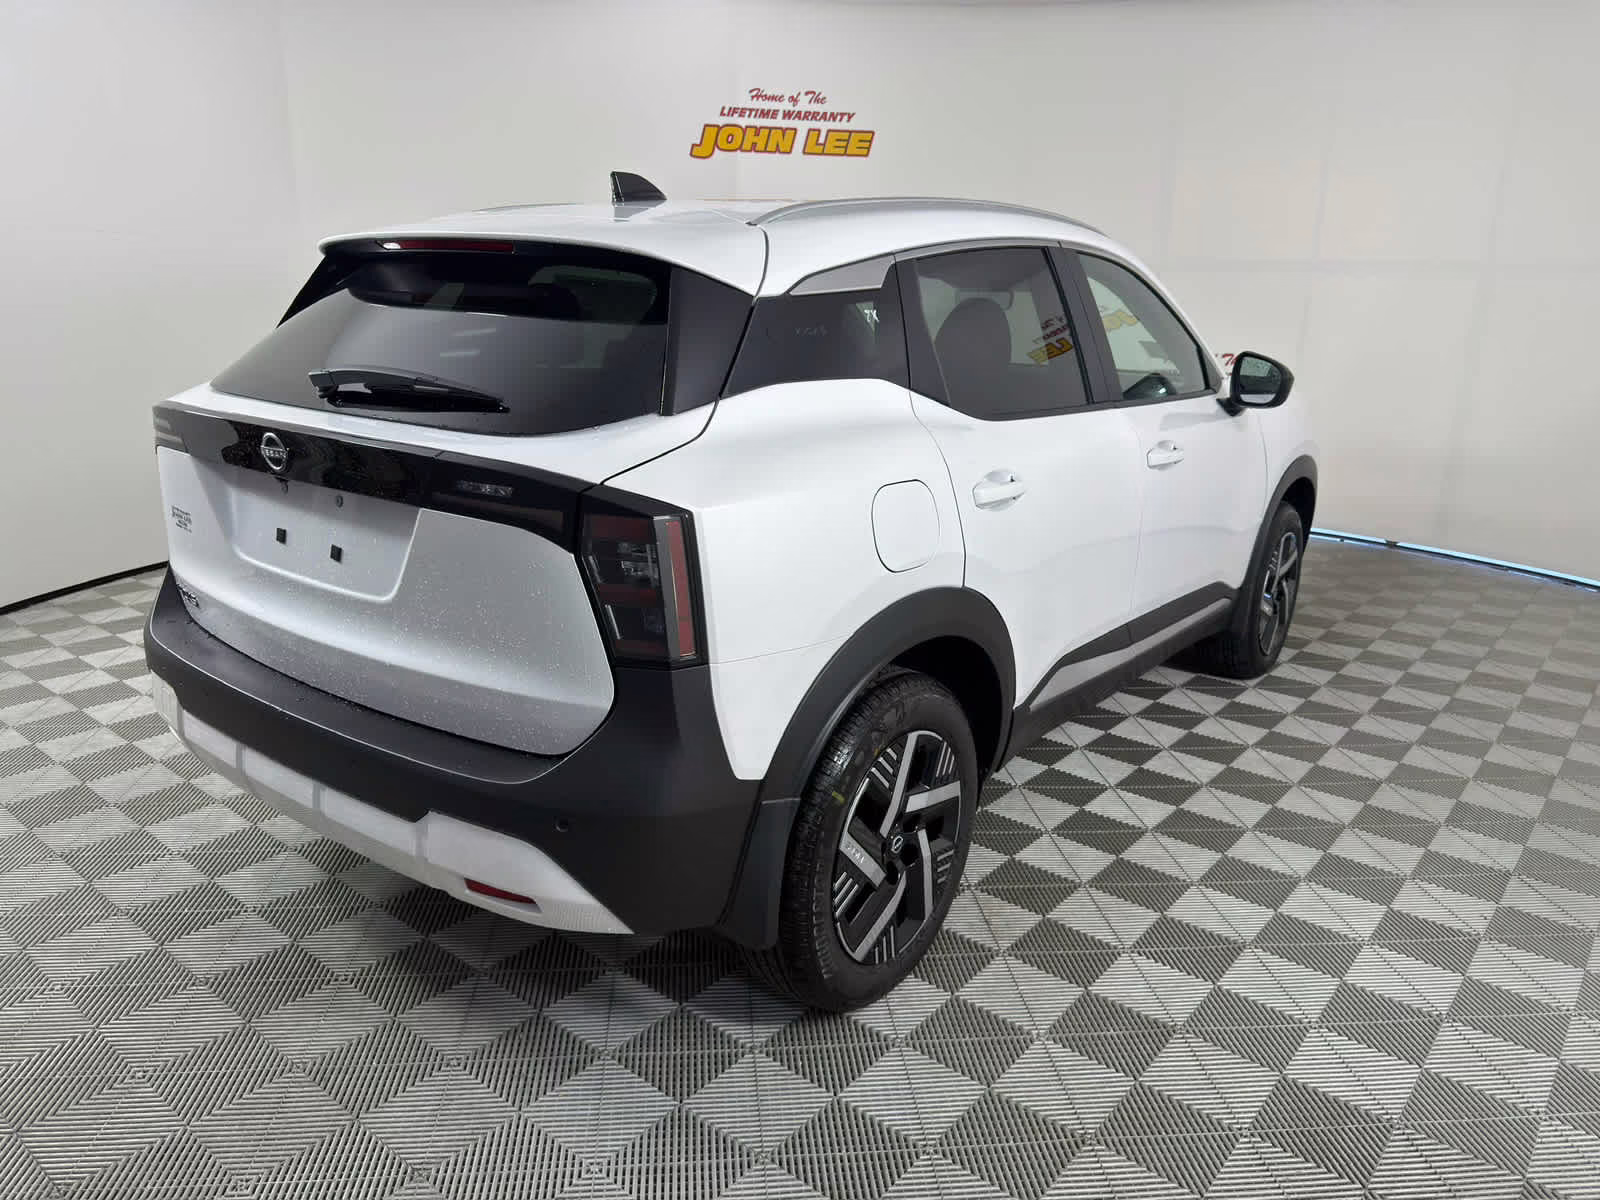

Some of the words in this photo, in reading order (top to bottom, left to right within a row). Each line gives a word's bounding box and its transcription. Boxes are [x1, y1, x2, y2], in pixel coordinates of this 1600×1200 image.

[748, 87, 785, 103] Home
[787, 91, 800, 107] of
[804, 90, 828, 105] The
[719, 105, 780, 121] LIFETIME
[781, 109, 856, 123] WARRANTY
[689, 123, 797, 160] JOHN
[802, 127, 875, 158] LEE
